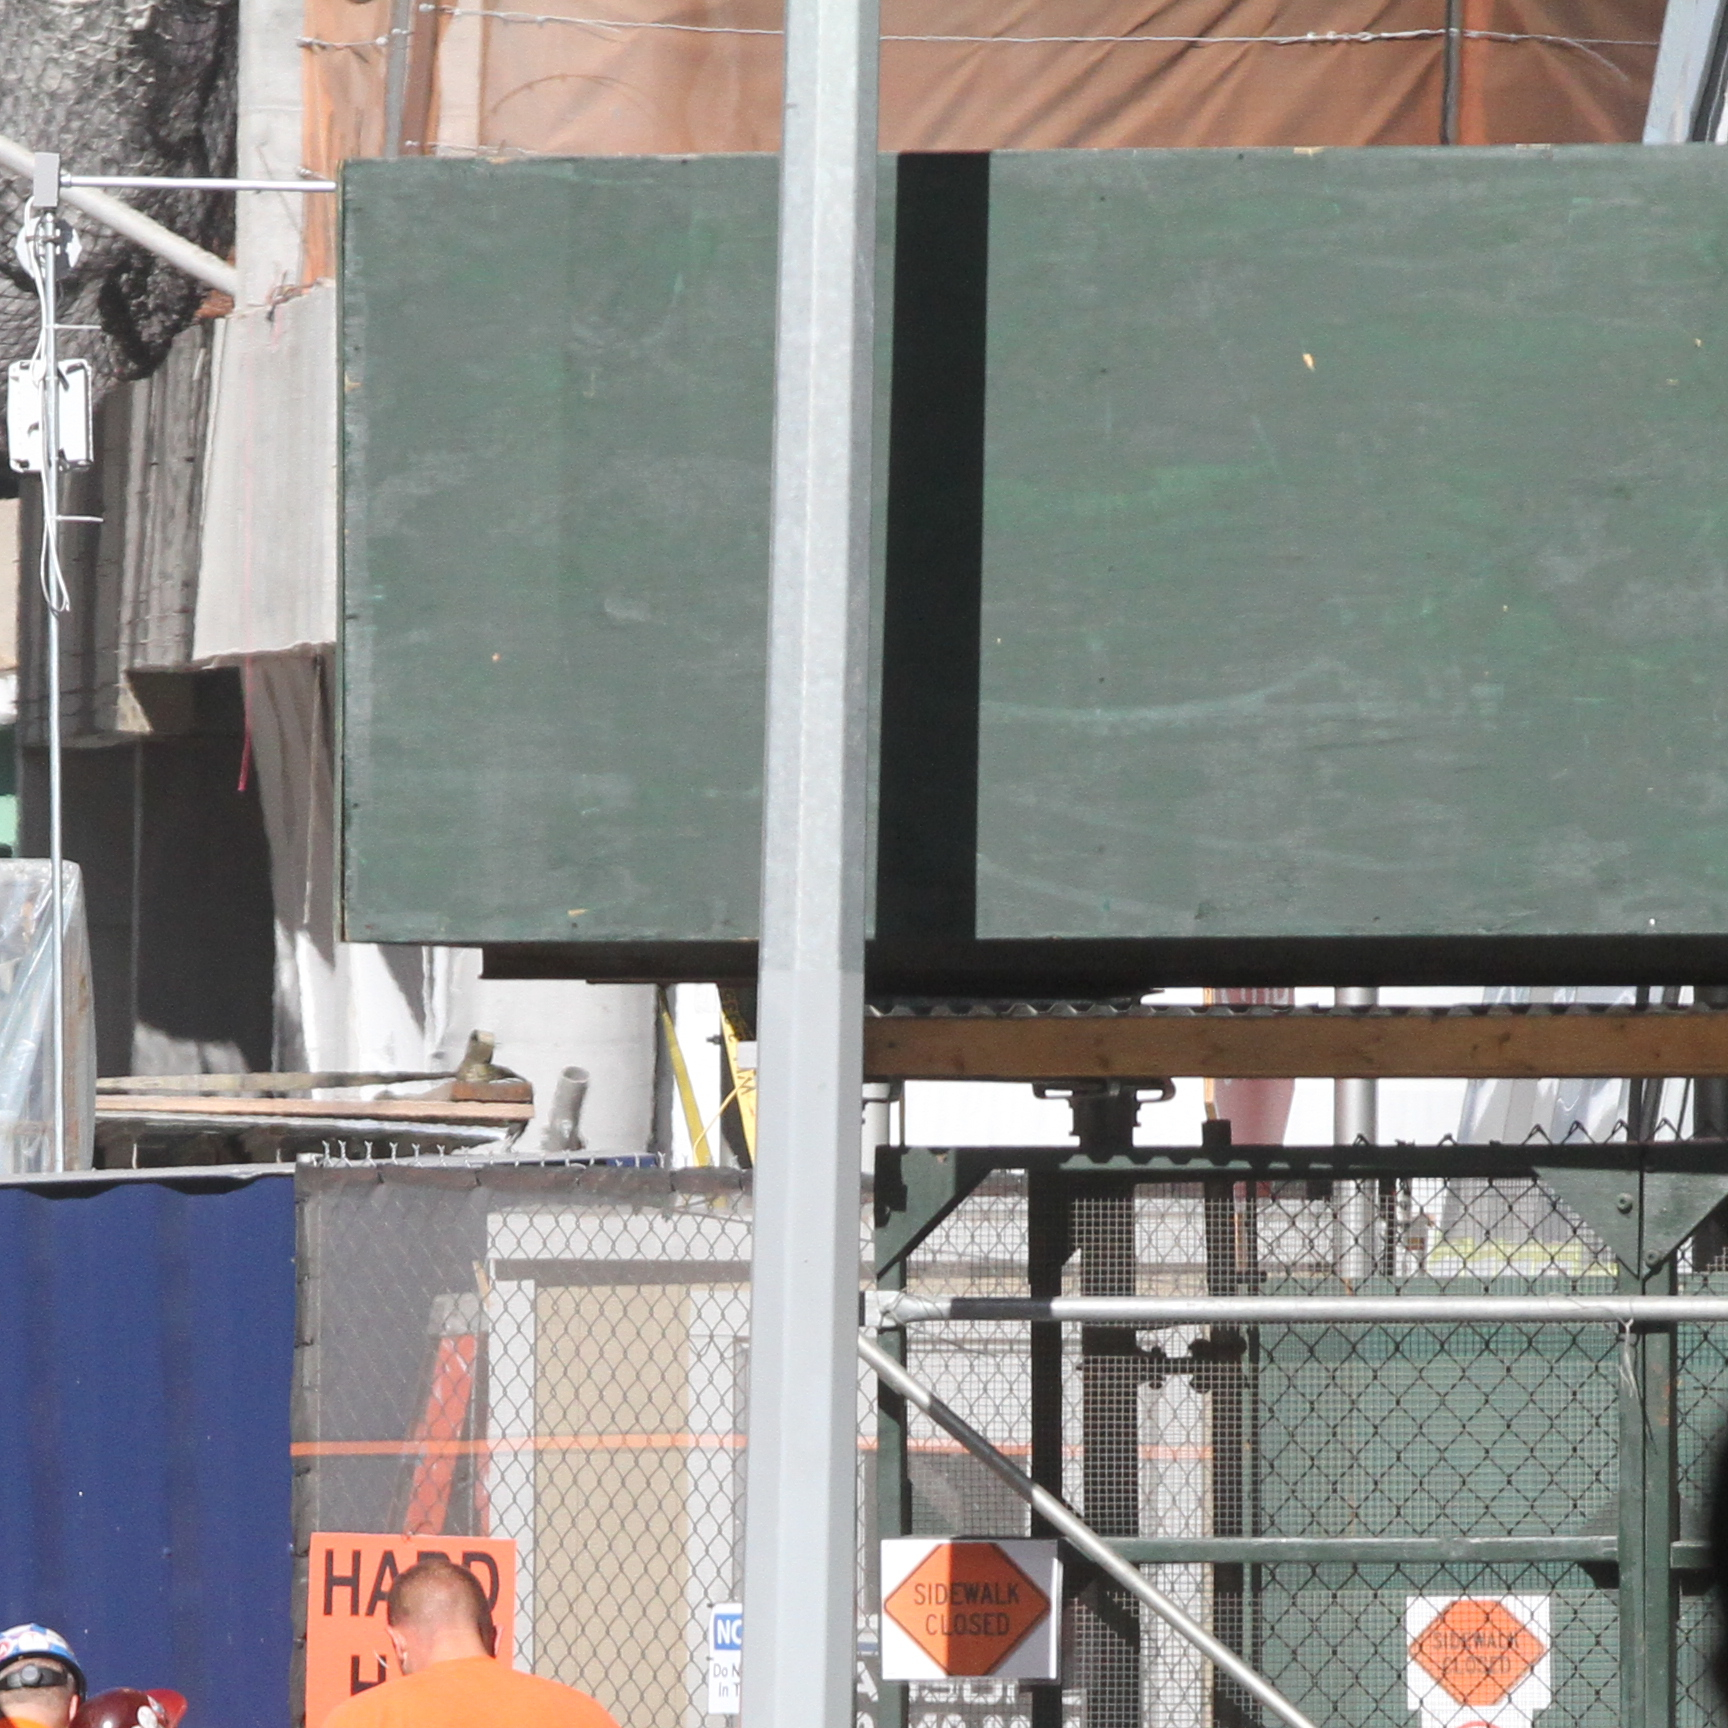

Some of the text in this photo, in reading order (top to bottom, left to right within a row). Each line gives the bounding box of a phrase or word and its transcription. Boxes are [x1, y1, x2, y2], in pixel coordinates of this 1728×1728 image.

[323, 1549, 499, 1616] HAD
[914, 1582, 1020, 1605] SIDEWALK
[925, 1613, 1010, 1636] CLOSED
[1432, 1631, 1520, 1650] SIDEWALK
[1442, 1656, 1512, 1675] CLOSED
